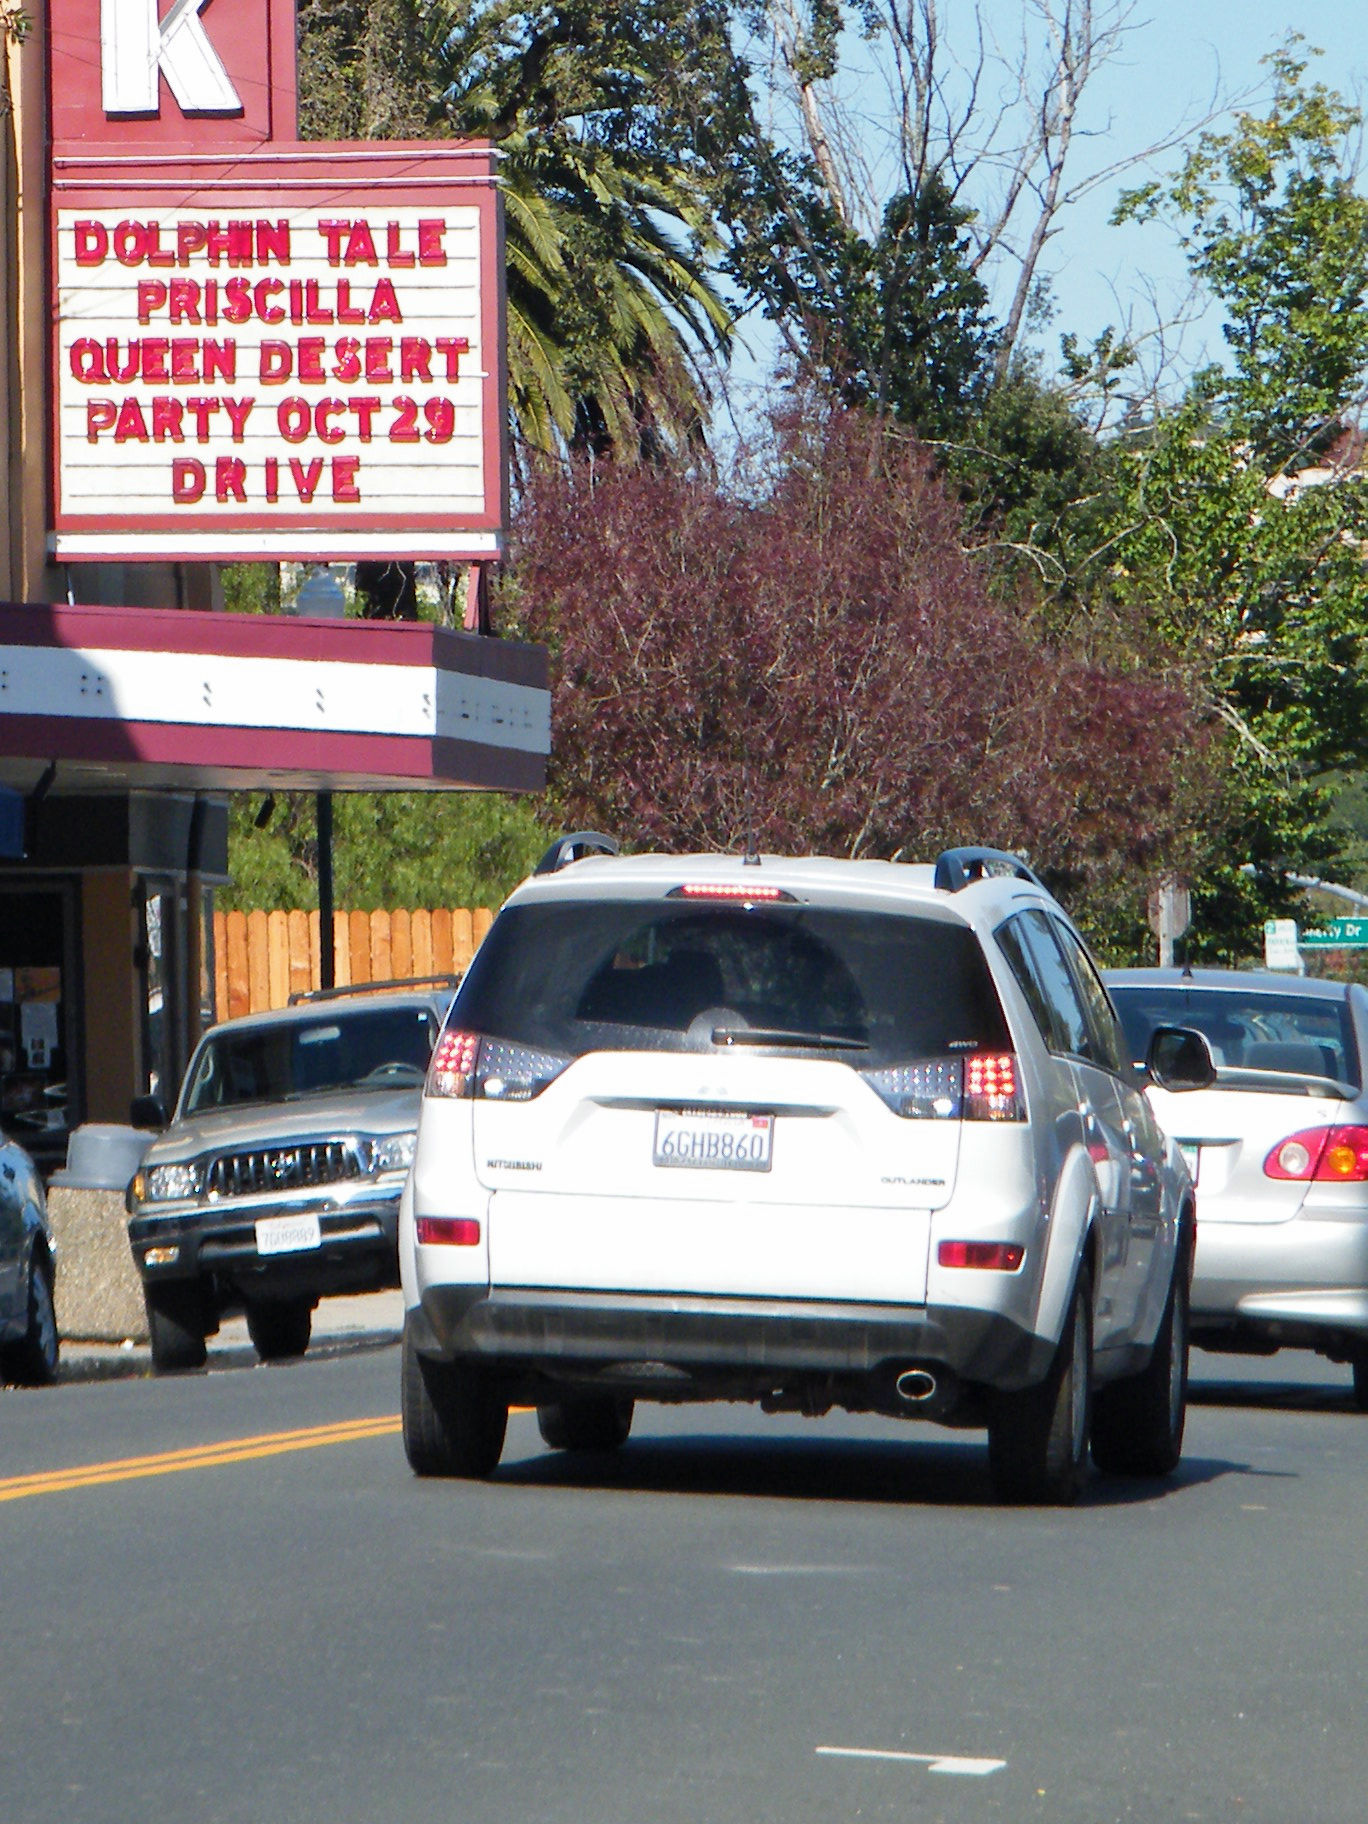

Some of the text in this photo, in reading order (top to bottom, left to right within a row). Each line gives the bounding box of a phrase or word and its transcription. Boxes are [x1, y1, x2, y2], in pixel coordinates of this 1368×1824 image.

[73, 218, 448, 268] DOLPHIN TALE
[136, 276, 403, 326] PRISCILLA
[69, 336, 470, 386] QUEEN DESERT
[87, 397, 256, 444] PARTY
[172, 455, 361, 504] DRIVE
[1345, 923, 1363, 937] Dr
[662, 1130, 764, 1161] 6GHB860
